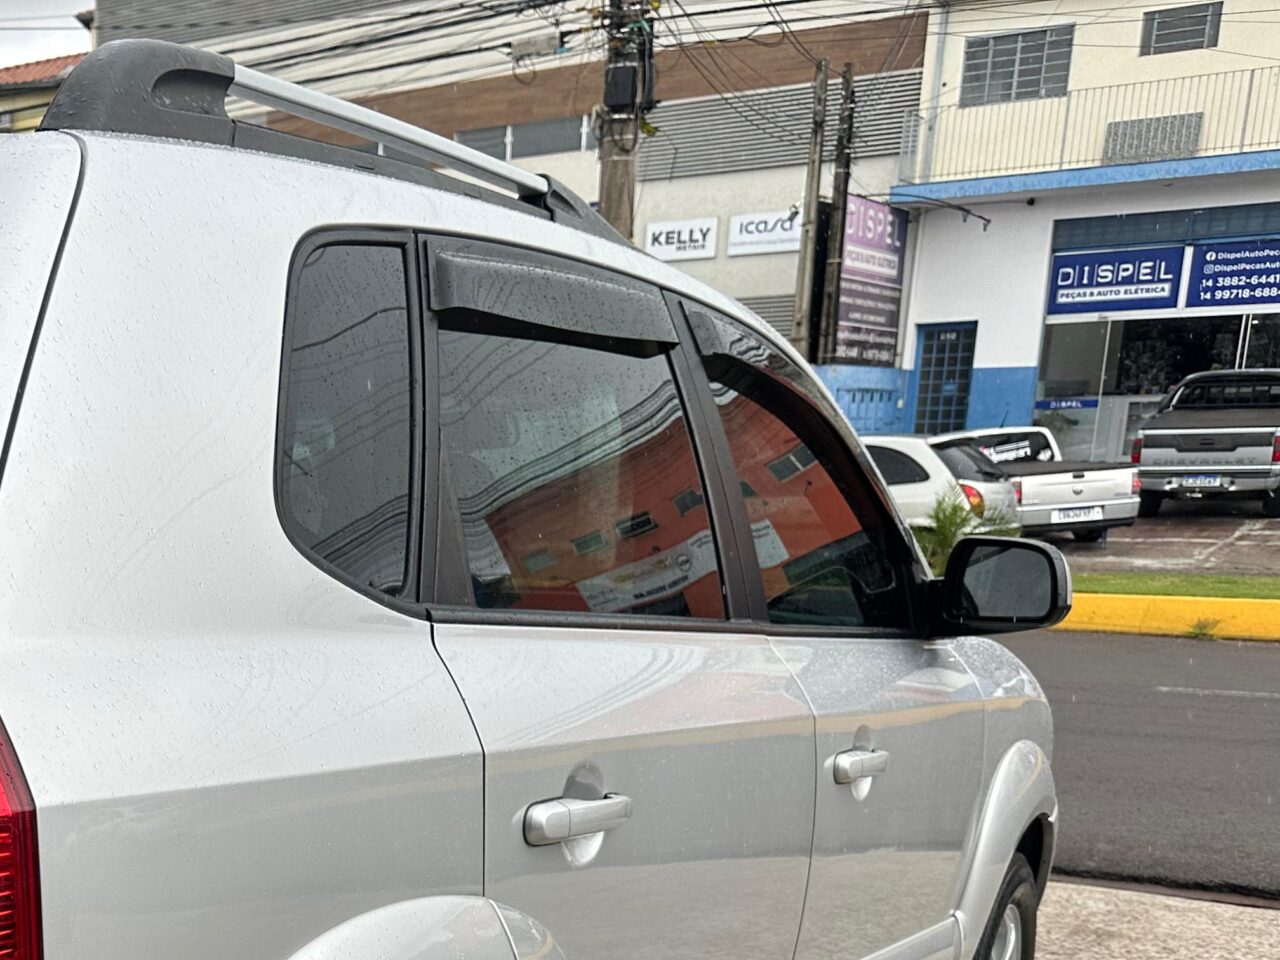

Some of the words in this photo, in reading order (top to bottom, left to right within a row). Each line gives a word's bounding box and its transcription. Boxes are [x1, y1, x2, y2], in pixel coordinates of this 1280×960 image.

[847, 203, 901, 247] DISPEL
[651, 228, 711, 246] KELLY
[1057, 260, 1174, 286] DISPEL
[1202, 279, 1213, 287] 14
[1216, 274, 1280, 287] 3882-6441
[1060, 291, 1087, 299] PEÇAS
[1096, 289, 1121, 297] AUTO
[1123, 285, 1166, 295] ELÉTRICA
[1200, 292, 1211, 300] 14
